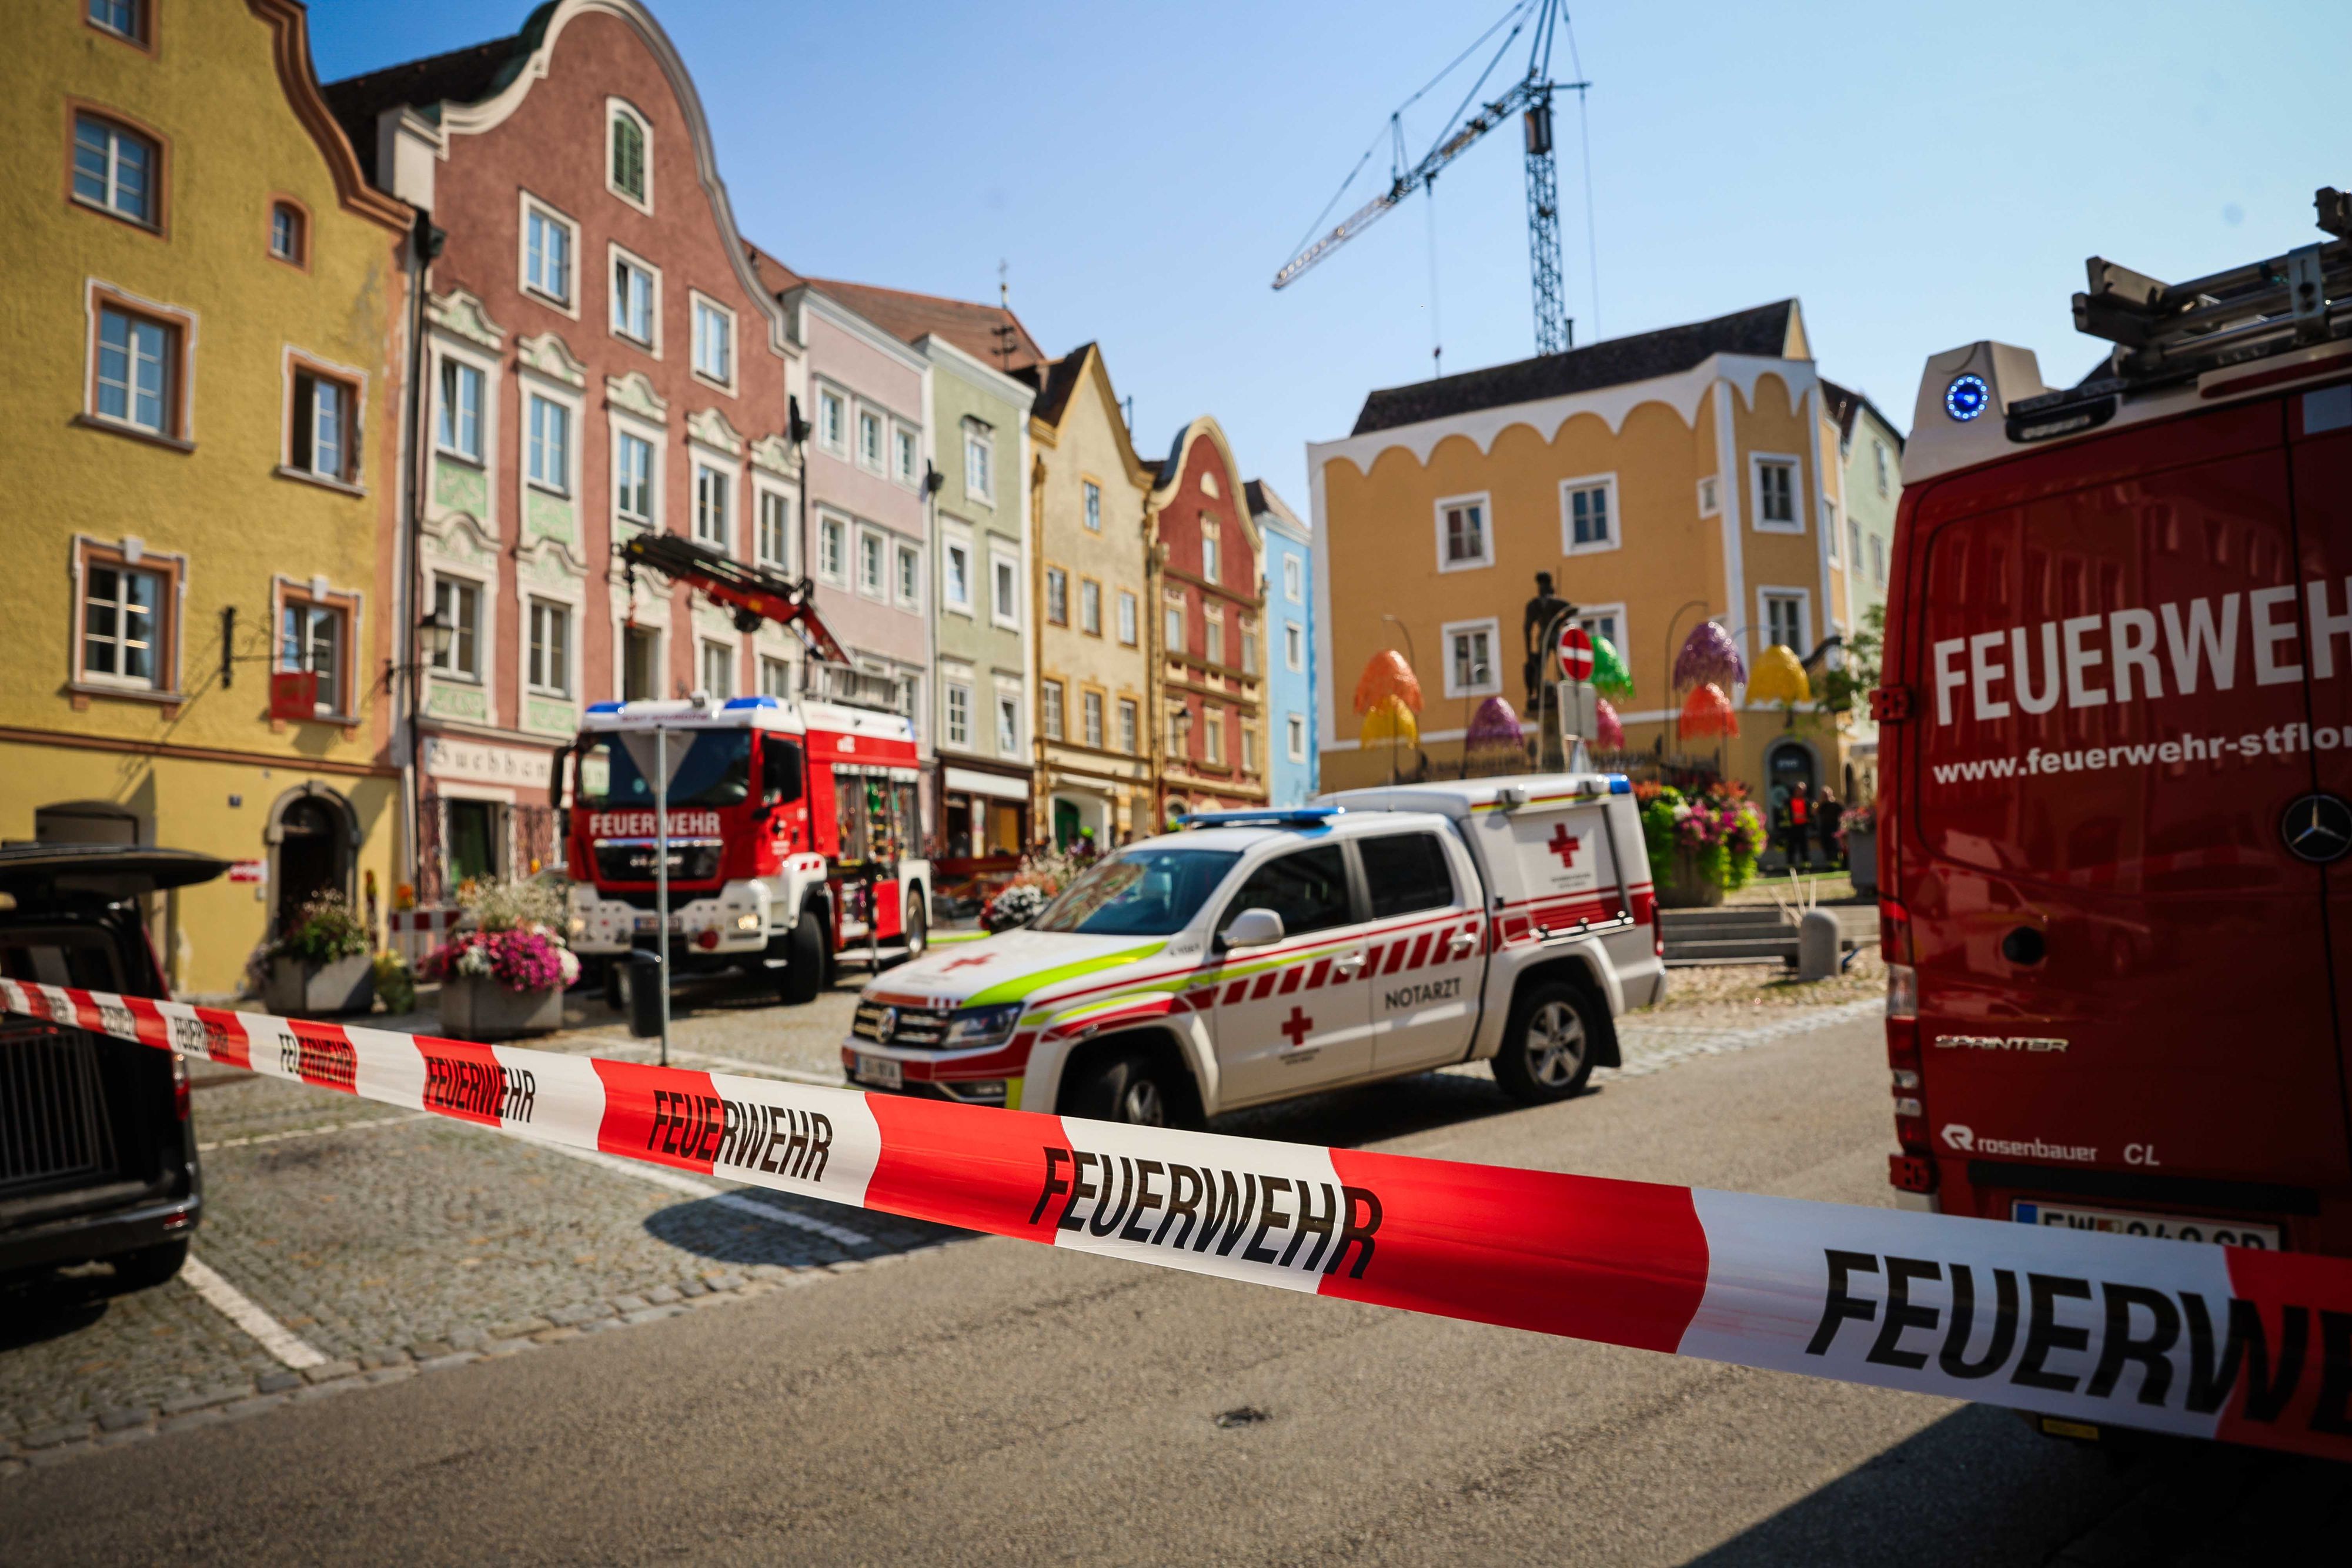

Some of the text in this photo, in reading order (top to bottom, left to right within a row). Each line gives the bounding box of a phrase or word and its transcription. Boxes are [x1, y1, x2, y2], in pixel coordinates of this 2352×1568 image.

[1933, 576, 2352, 726] FEUERWEH
[1385, 977, 1461, 1009] NOTARZT
[1935, 1034, 2069, 1052] SPRINTER
[424, 1055, 536, 1124] FEUERWEHR
[647, 1089, 833, 1182] FEUERWEHR
[1977, 1136, 2097, 1162] rosenbauer
[2123, 1143, 2160, 1166] CL
[1029, 1146, 1383, 1280] FEUERWEHR
[1805, 1249, 2352, 1436] FEUERWE
